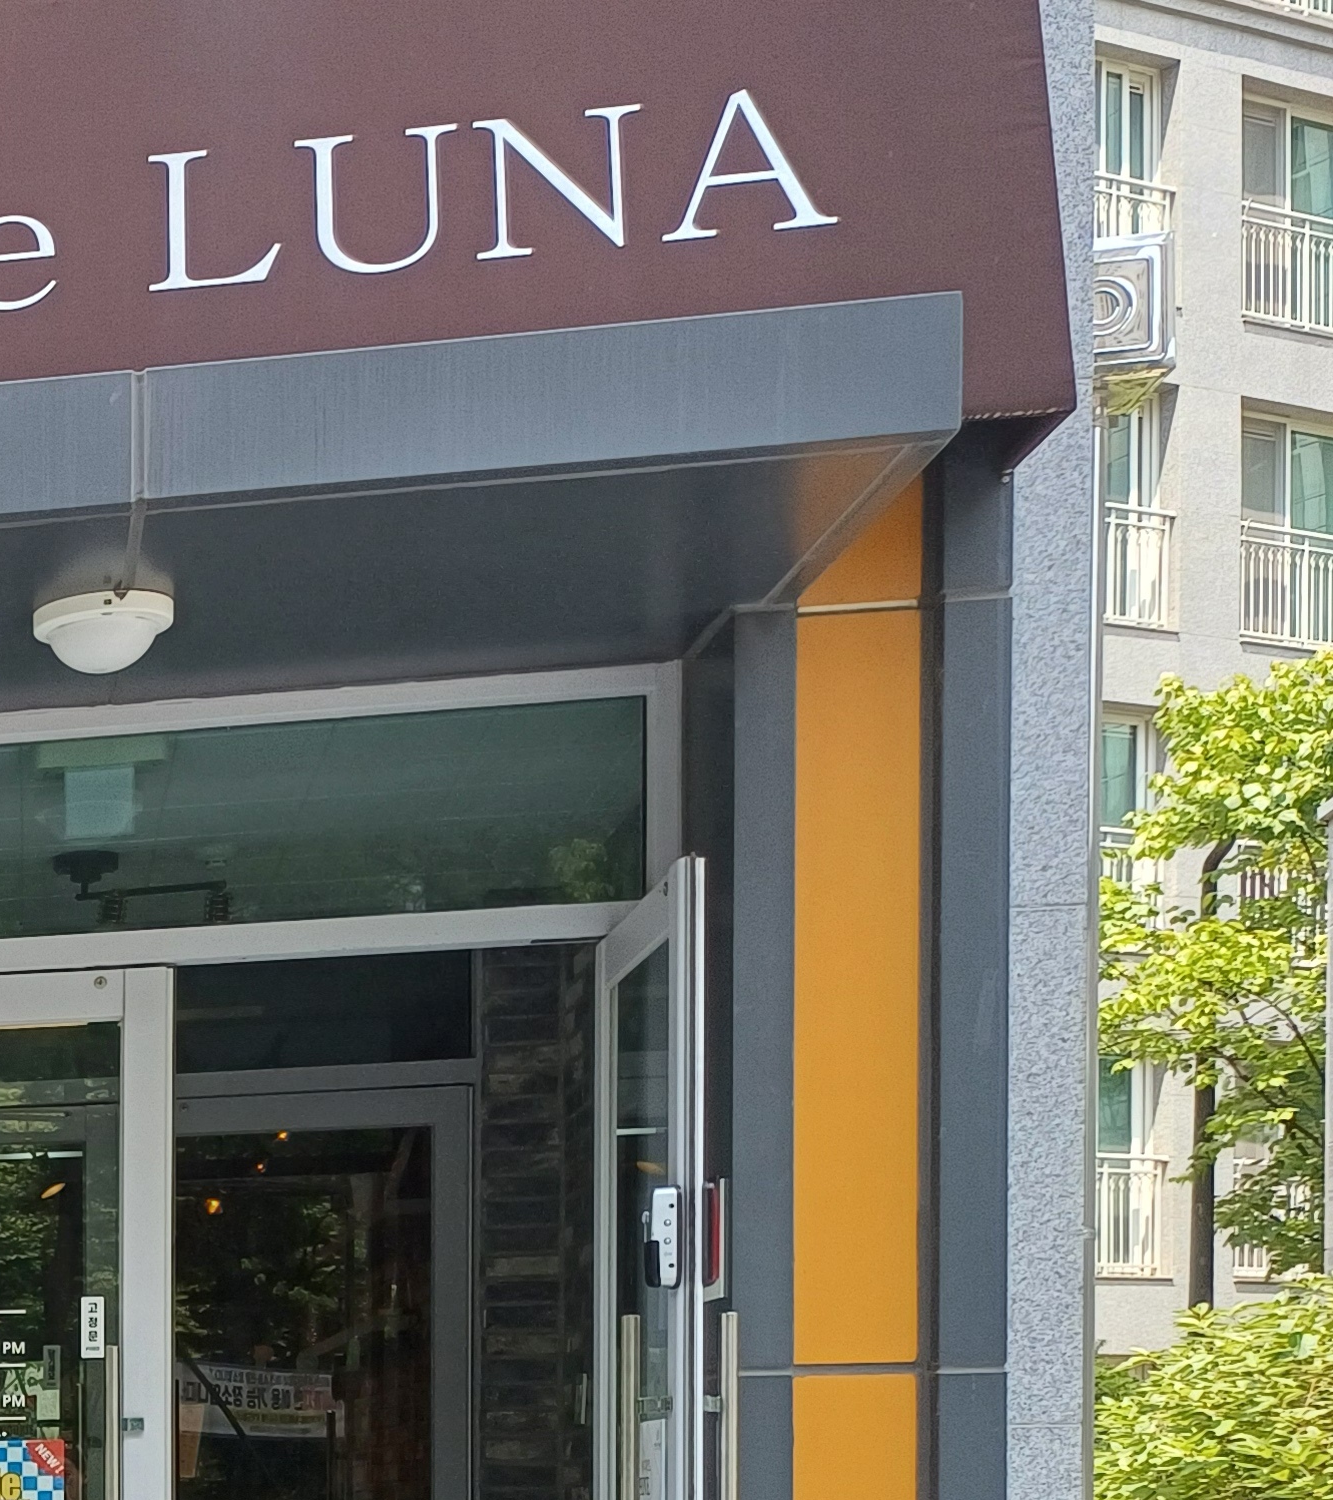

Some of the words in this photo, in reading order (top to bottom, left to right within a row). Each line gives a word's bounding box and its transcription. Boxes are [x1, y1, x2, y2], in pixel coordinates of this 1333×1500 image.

[146, 88, 840, 295] LUNA
[3, 1341, 26, 1354] PM
[3, 1394, 26, 1407] PM
